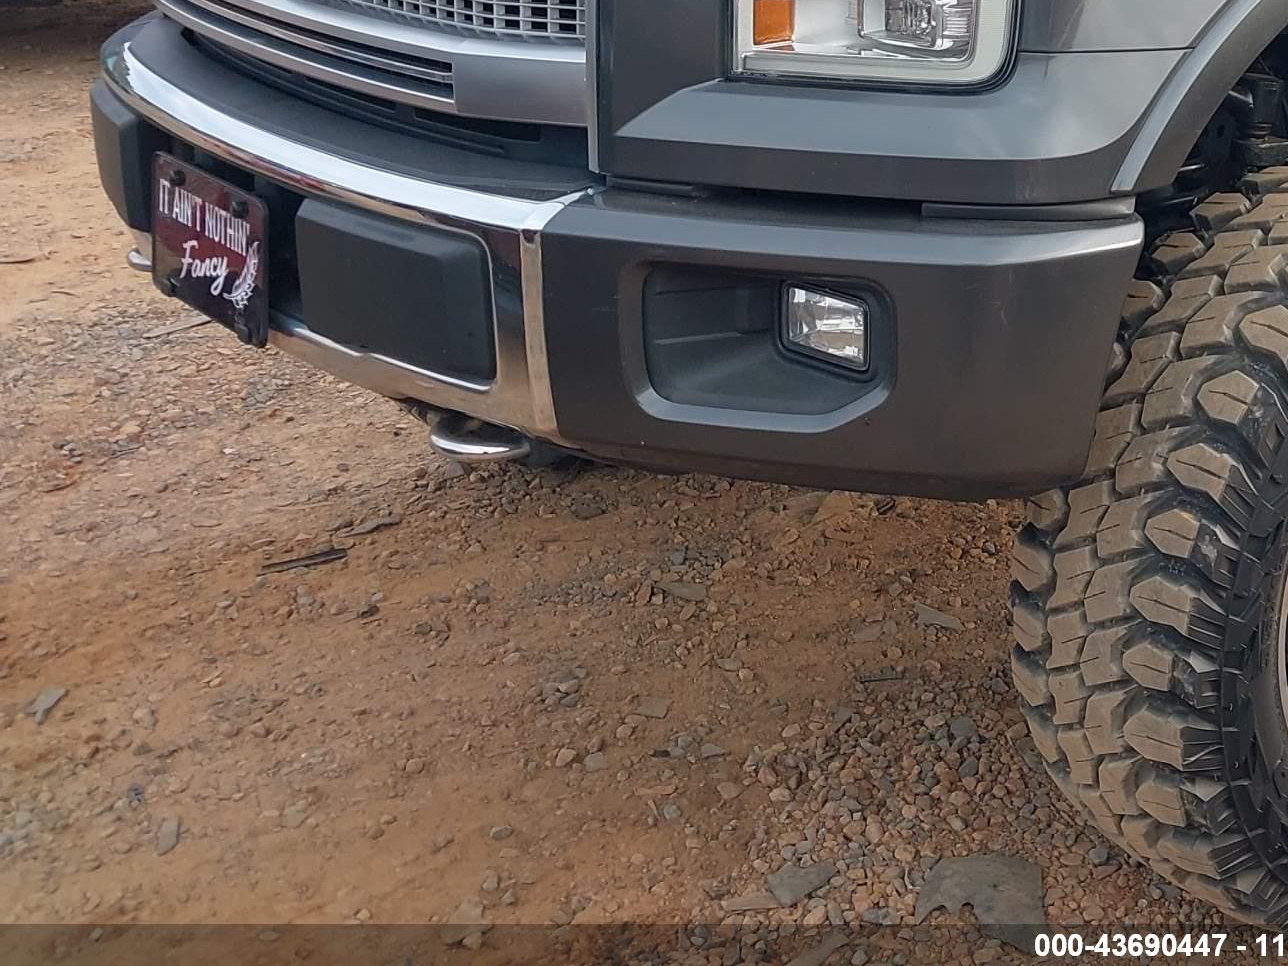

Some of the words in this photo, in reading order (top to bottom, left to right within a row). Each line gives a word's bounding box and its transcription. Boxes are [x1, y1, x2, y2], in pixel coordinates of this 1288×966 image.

[158, 178, 171, 214] IT
[172, 186, 202, 232] AIN'T
[179, 240, 229, 296] Fancy
